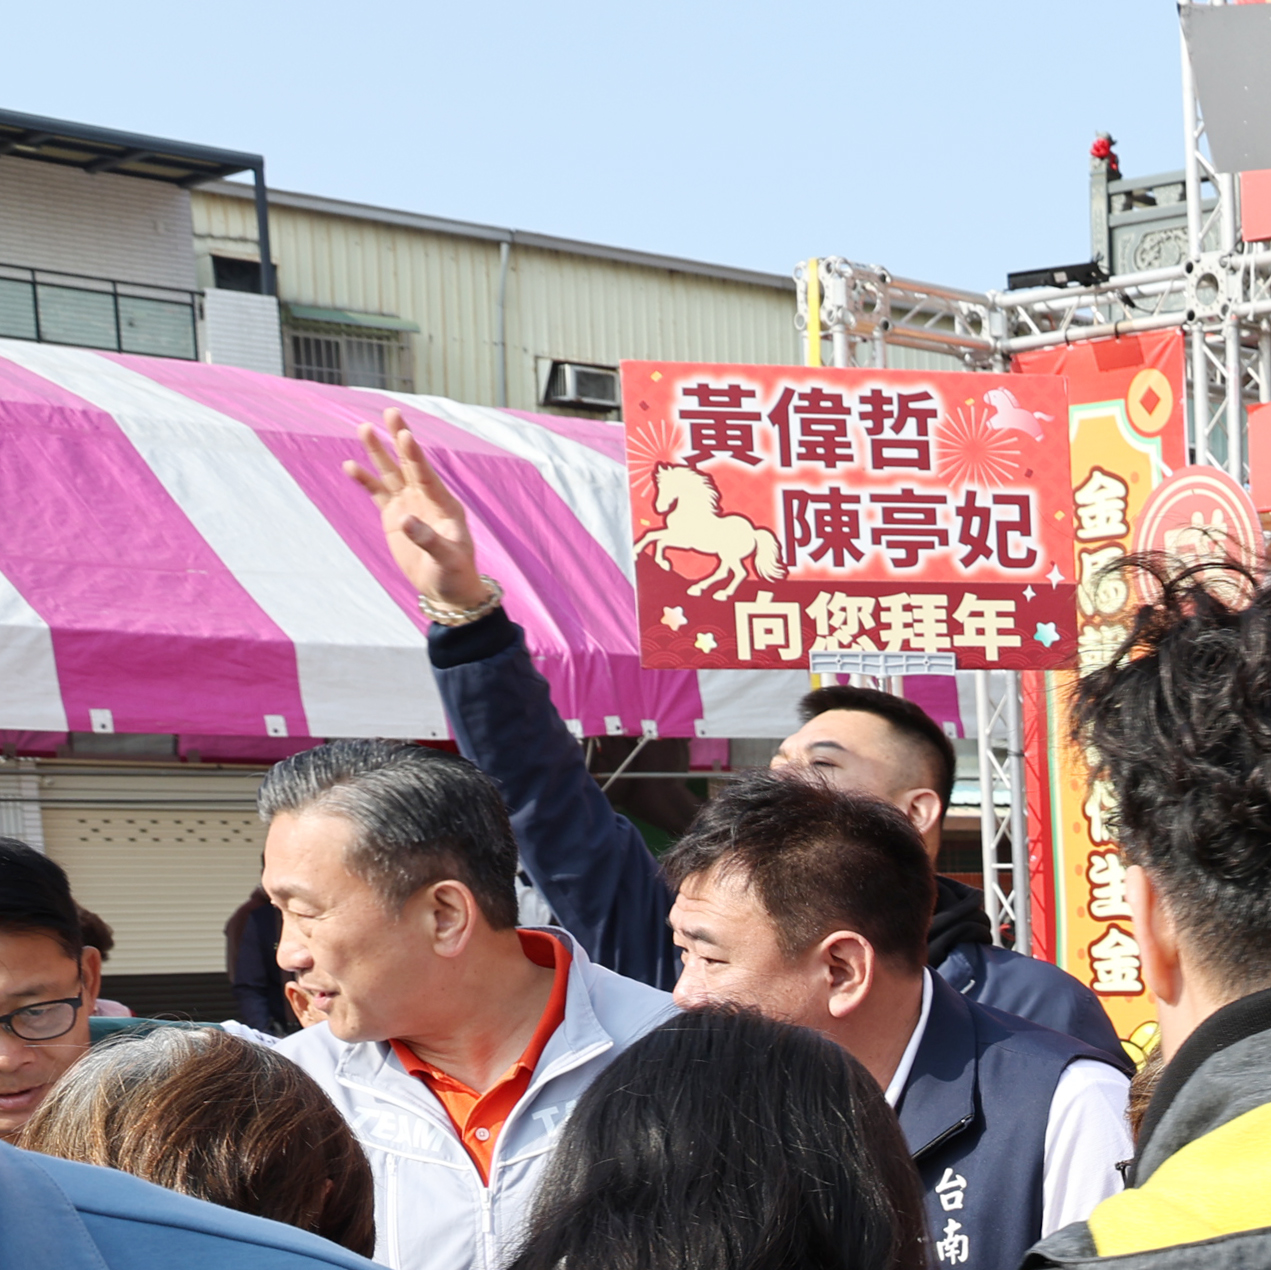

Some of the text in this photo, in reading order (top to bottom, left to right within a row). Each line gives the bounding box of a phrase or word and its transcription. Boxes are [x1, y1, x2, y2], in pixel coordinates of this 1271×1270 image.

[678, 382, 938, 473] 黃偉哲
[780, 487, 1038, 571] 陳亭妃
[733, 591, 1023, 662] 向您拜年
